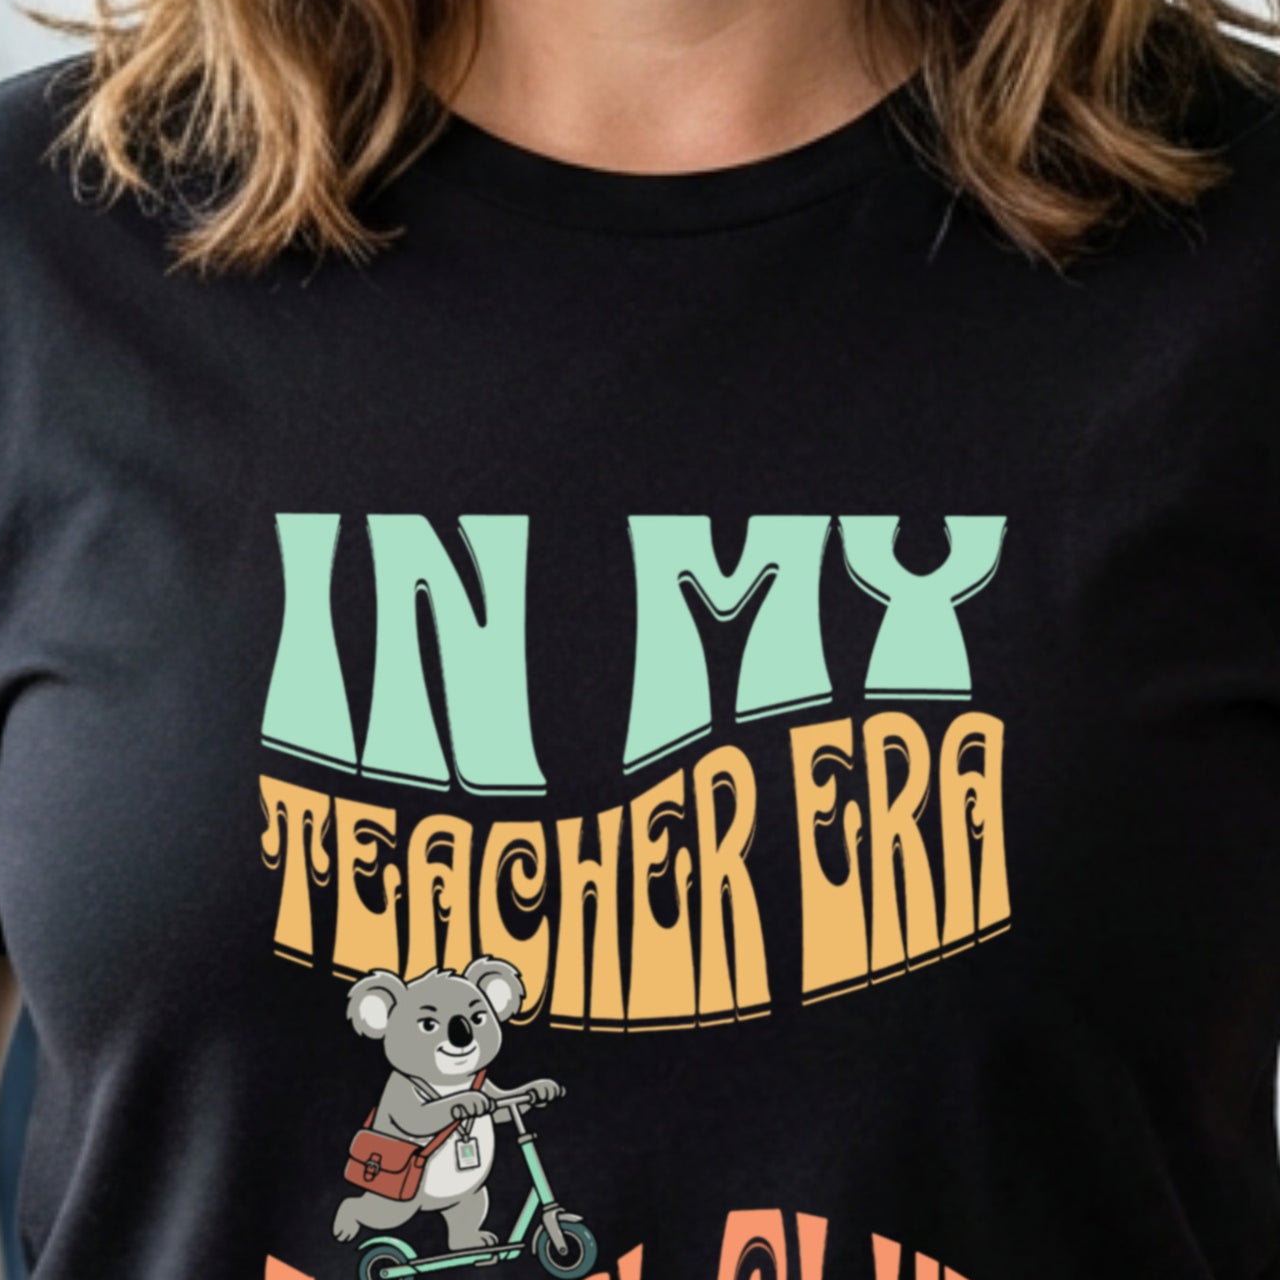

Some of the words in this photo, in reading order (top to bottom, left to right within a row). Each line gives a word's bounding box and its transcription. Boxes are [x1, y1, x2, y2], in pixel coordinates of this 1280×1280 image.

[260, 512, 548, 797] IN
[621, 514, 1008, 776] MY
[259, 774, 771, 1034] TEACHER
[790, 710, 1012, 1007] ERA
